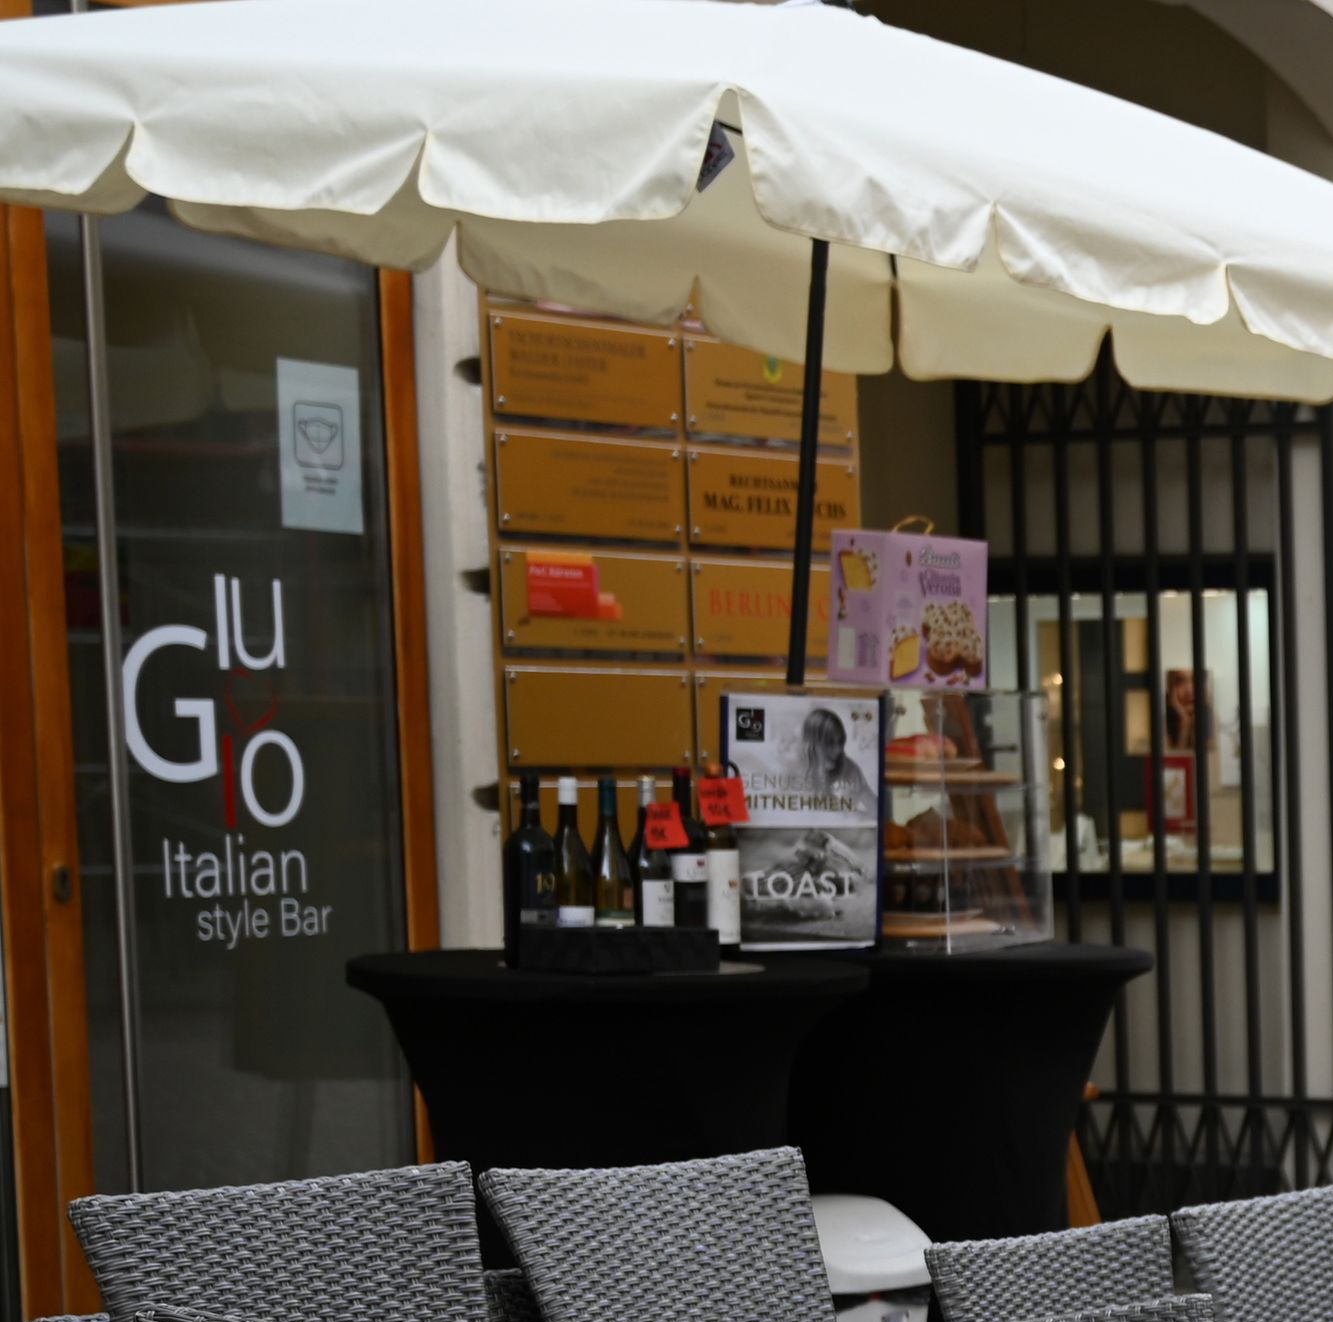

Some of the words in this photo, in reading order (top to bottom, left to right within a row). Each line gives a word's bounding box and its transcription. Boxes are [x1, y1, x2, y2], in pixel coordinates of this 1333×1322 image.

[747, 496, 791, 515] FELIX
[163, 833, 308, 898] Italian
[748, 870, 857, 900] TOAST
[197, 899, 270, 951] style
[281, 898, 333, 937] Bar
